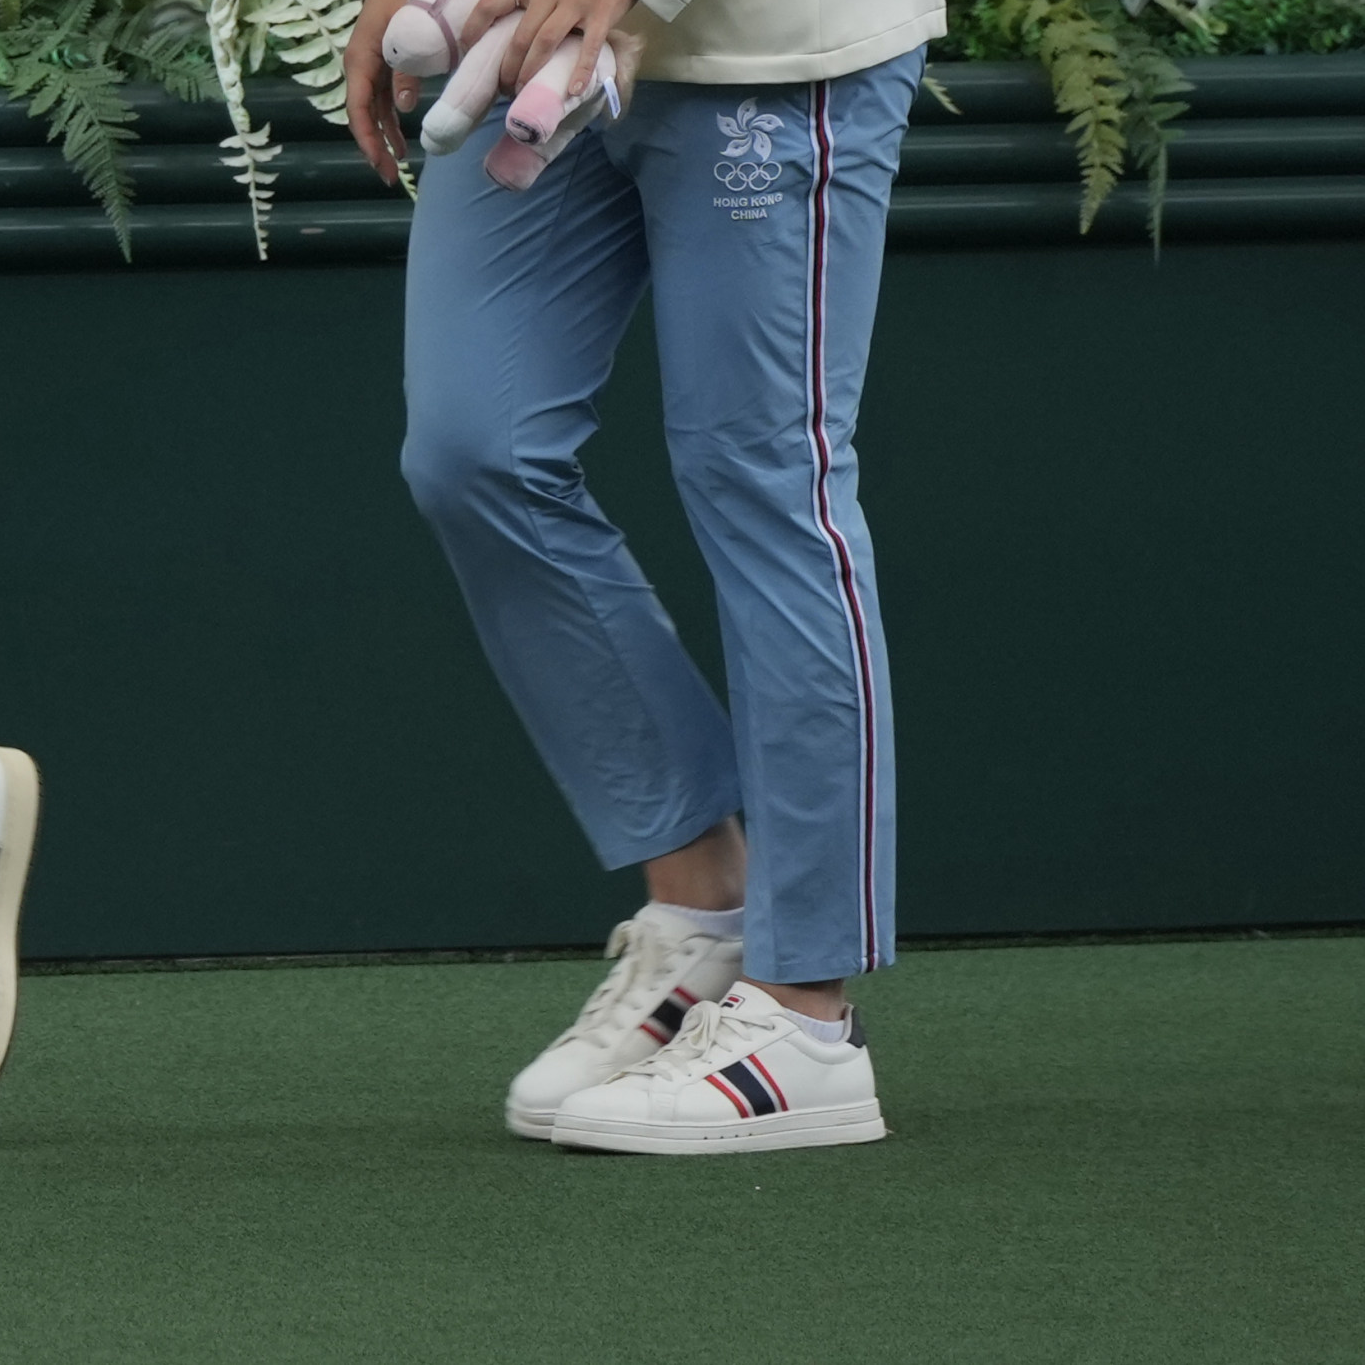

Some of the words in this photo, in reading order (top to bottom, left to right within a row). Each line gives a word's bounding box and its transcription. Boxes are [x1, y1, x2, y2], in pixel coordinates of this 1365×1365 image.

[713, 197, 748, 207] HONG
[750, 193, 783, 207] KONG
[731, 208, 767, 220] CHINA
